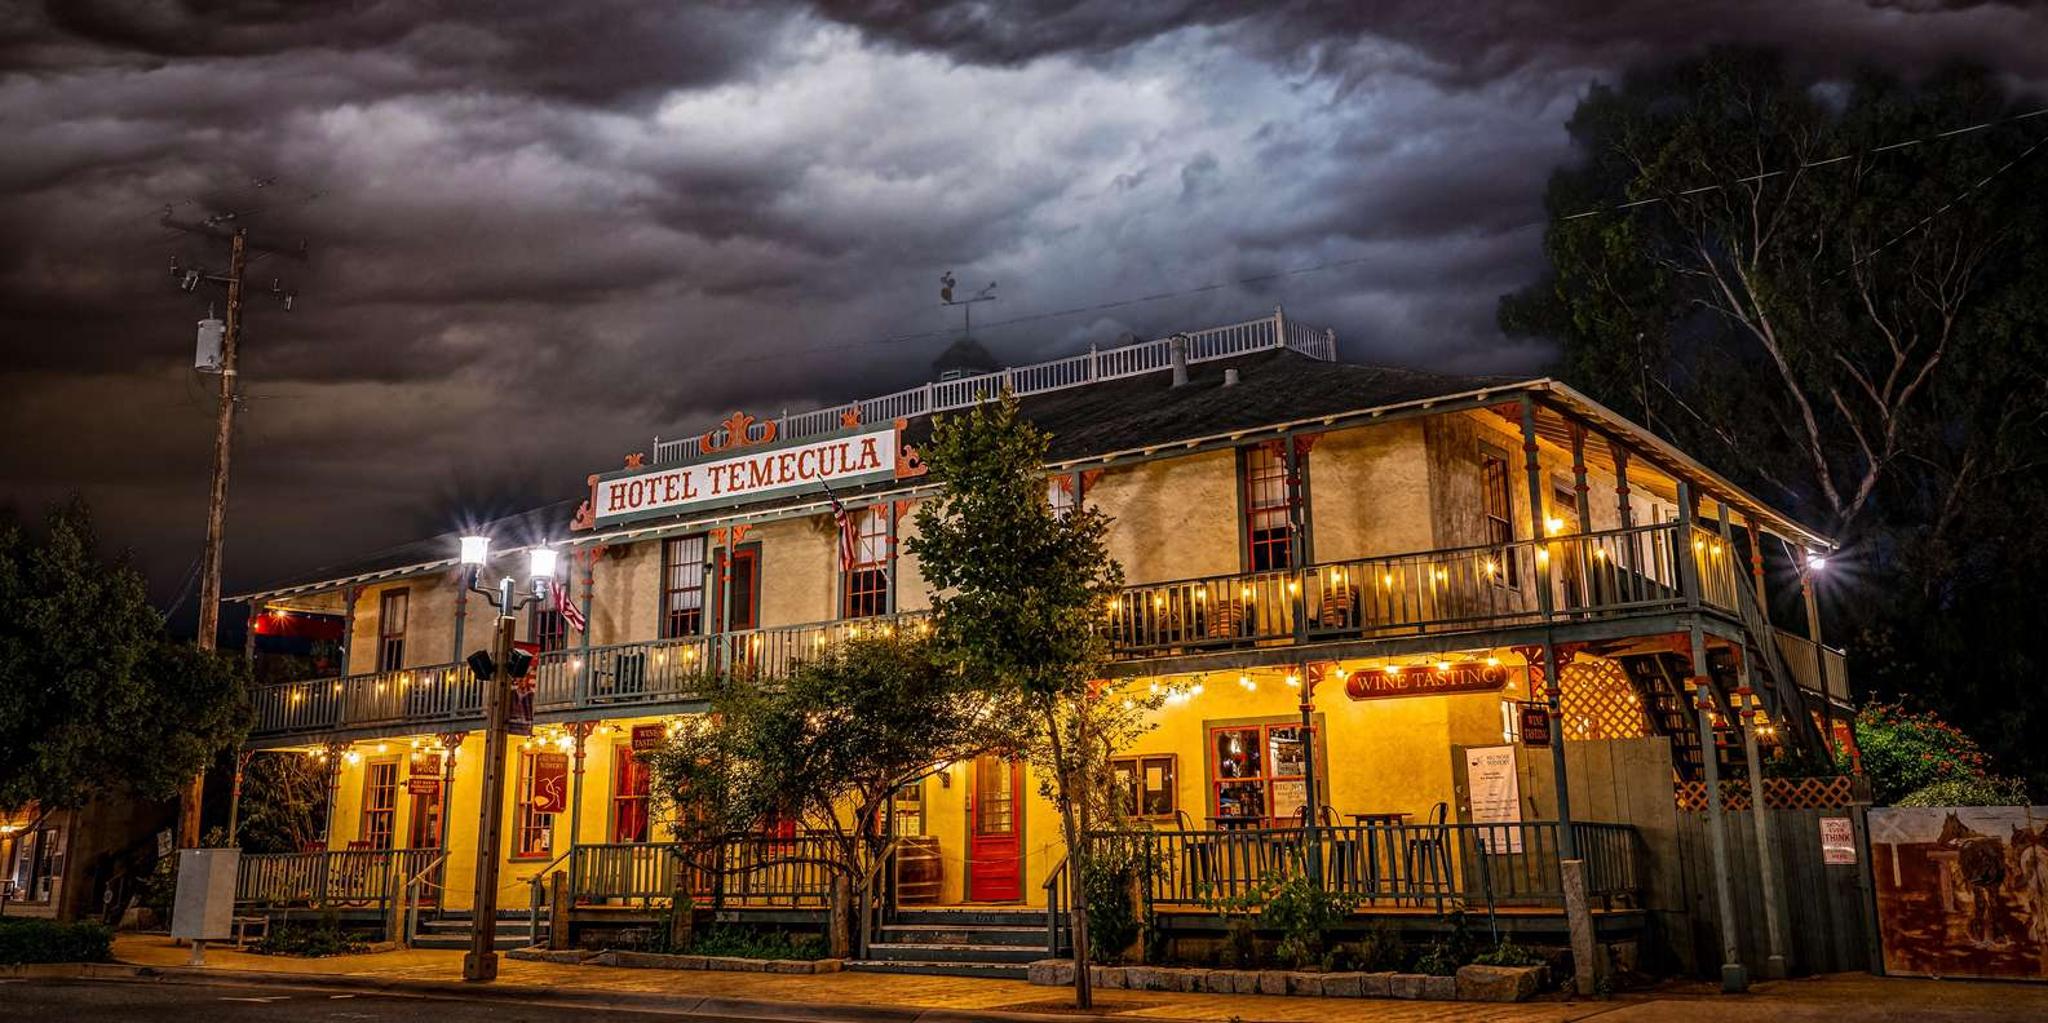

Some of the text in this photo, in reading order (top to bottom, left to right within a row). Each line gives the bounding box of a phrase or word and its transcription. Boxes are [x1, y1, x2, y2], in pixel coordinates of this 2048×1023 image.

[607, 436, 882, 512] HOTEL TEMECULA
[1357, 667, 1498, 691] WINE TASTING
[1823, 833, 1851, 842] THINK
